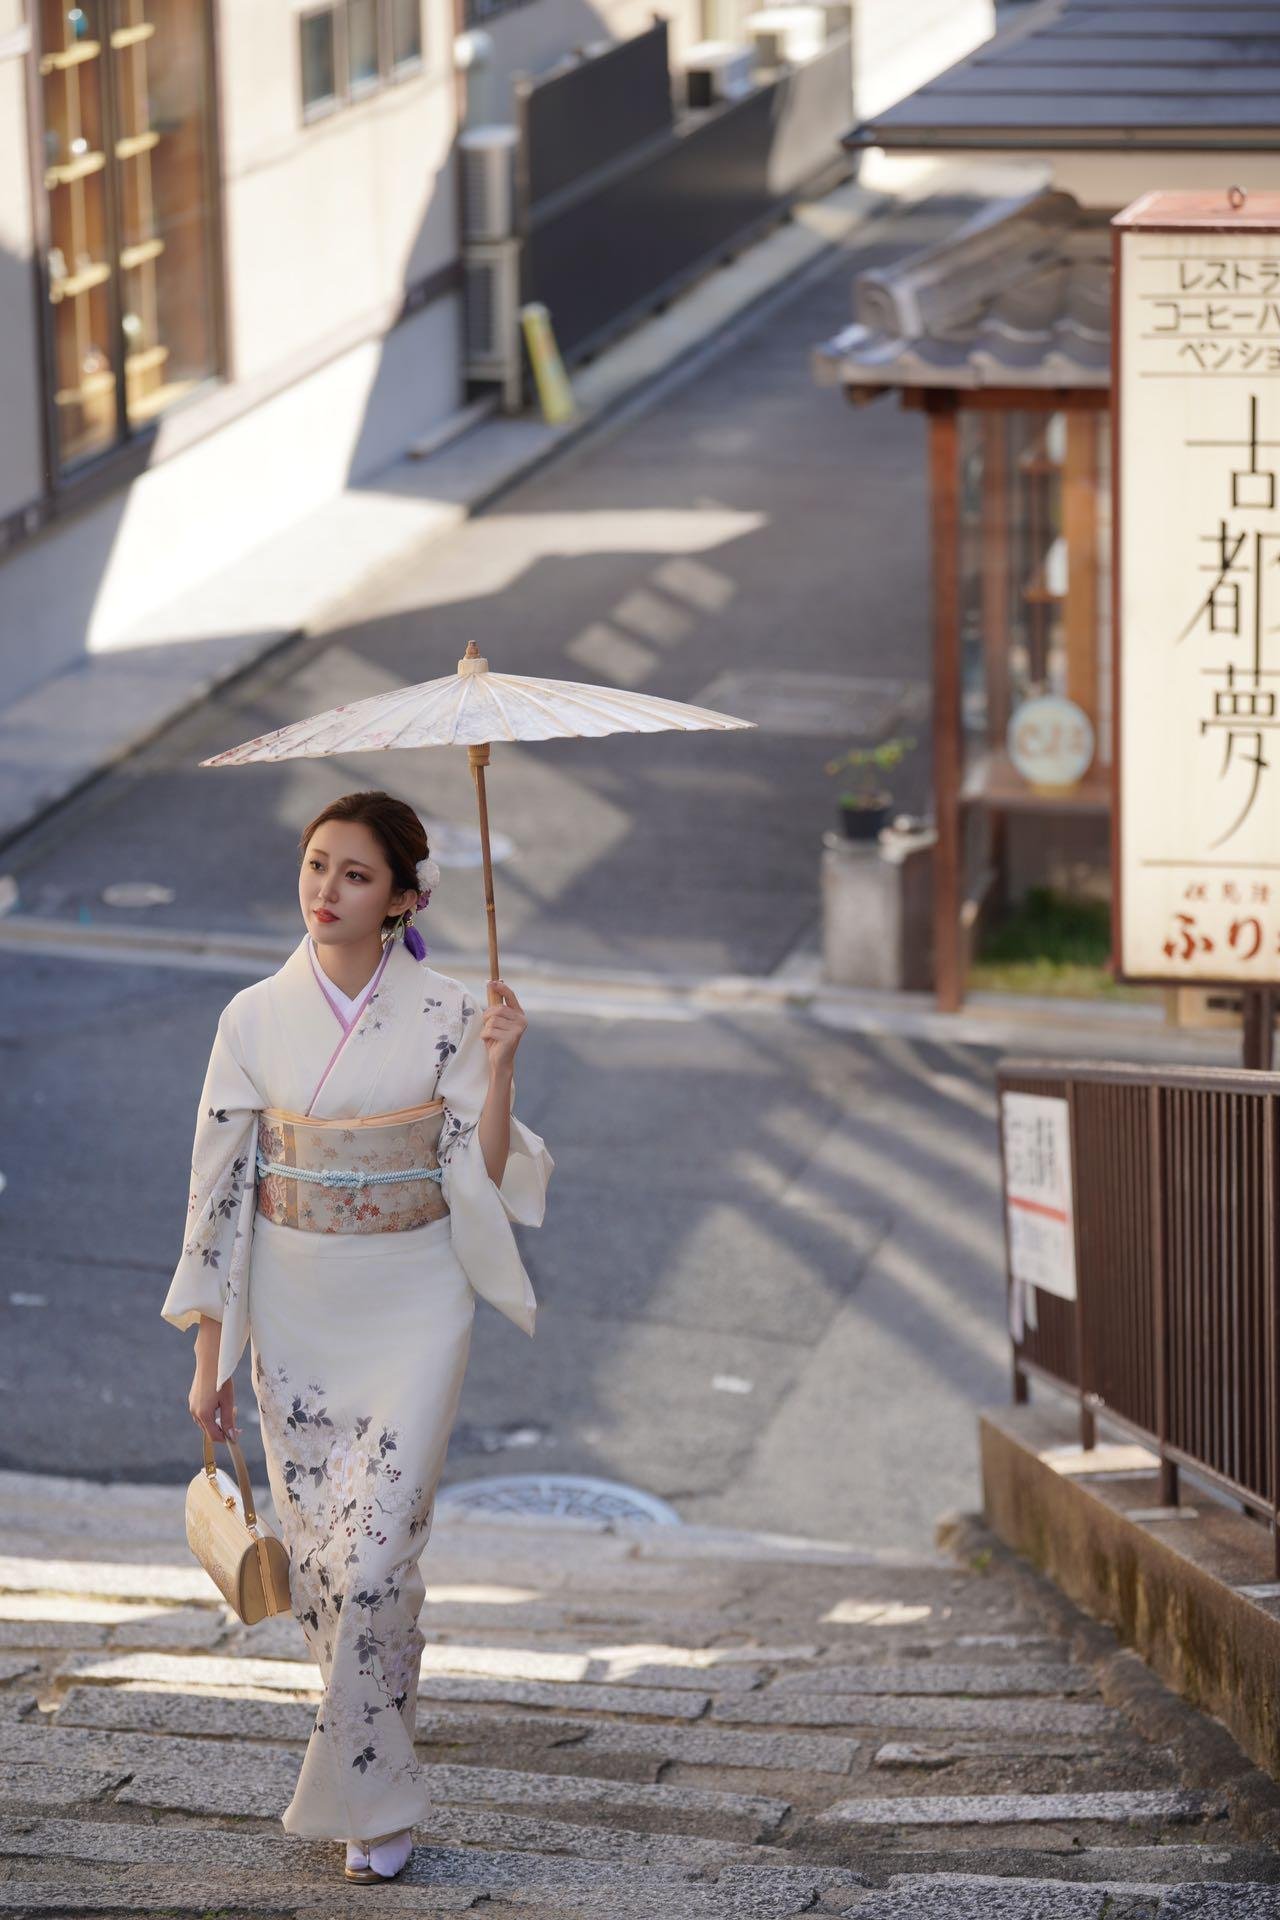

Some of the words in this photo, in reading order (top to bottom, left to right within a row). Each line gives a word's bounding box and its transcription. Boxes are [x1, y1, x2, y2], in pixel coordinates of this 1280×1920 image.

[1179, 262, 1280, 294] レストラ
[1175, 393, 1280, 851] 古都夢
[1162, 911, 1280, 962] ふり
